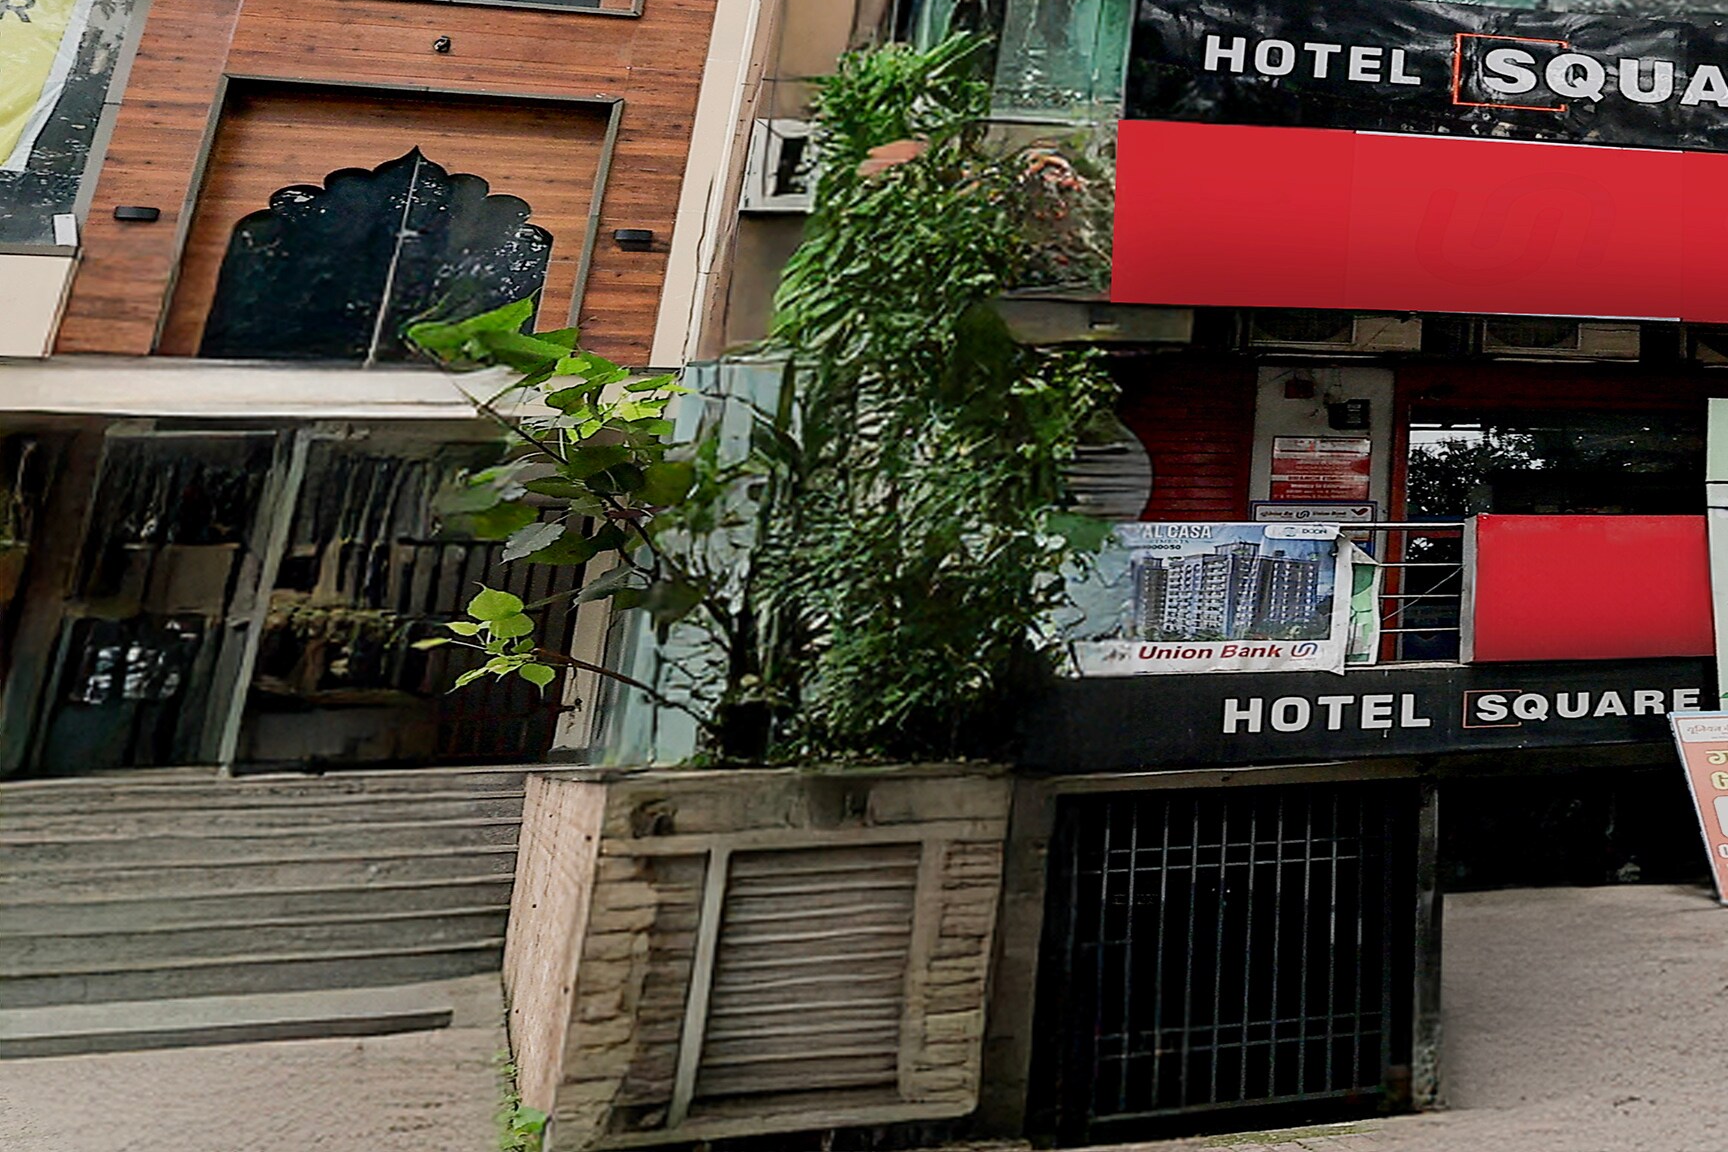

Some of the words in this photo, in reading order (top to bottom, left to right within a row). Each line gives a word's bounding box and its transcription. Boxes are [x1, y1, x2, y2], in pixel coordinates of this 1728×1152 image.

[1203, 35, 1422, 86] HOTEL
[1167, 525, 1213, 539] CASA
[1139, 644, 1213, 660] Union
[1220, 642, 1282, 659] Bank
[1223, 694, 1431, 734] HOTEL
[1475, 689, 1700, 722] SQUARE
